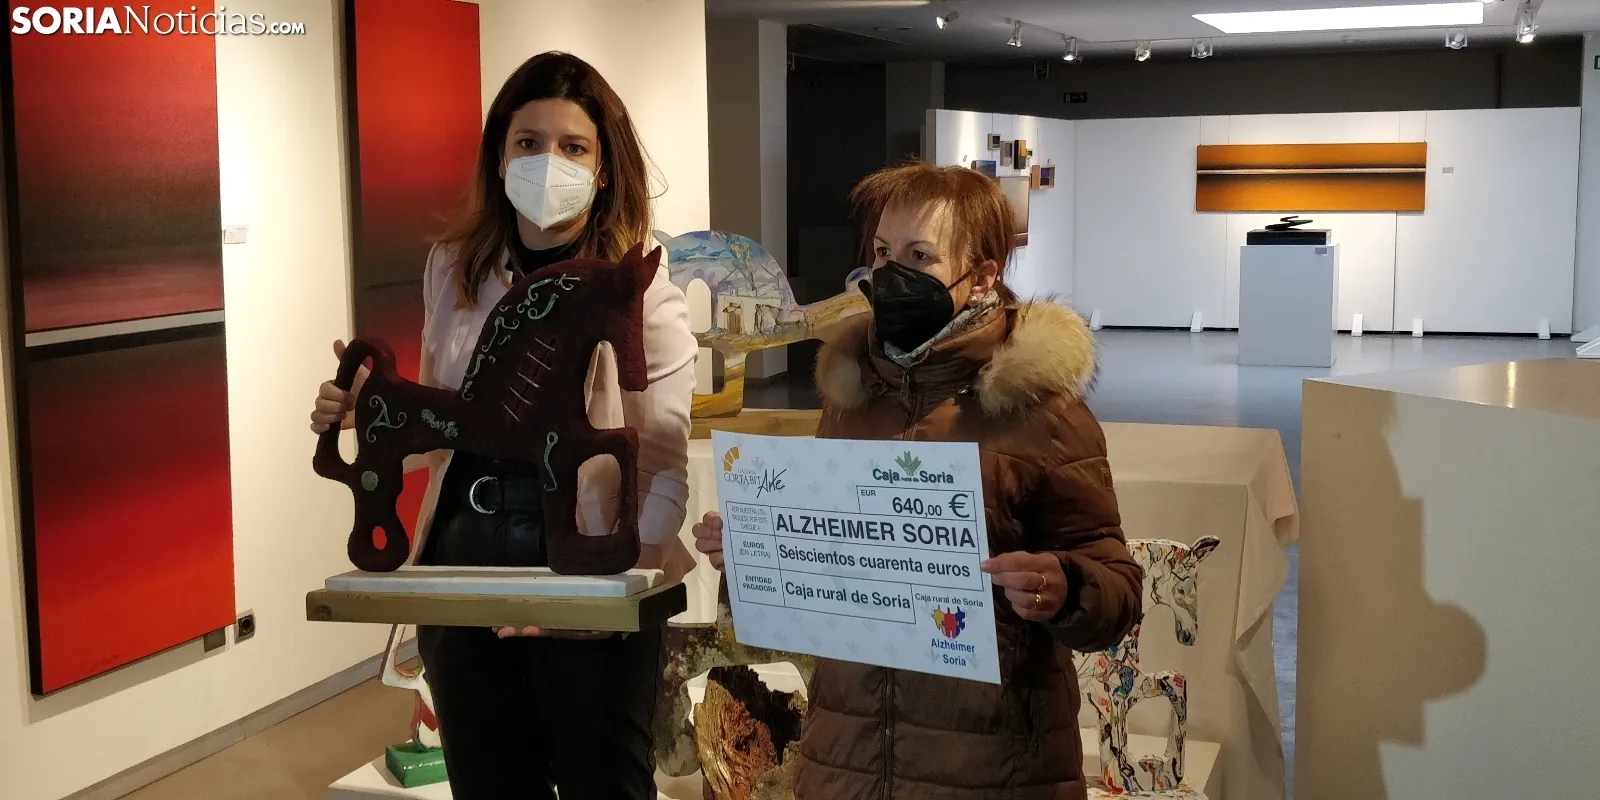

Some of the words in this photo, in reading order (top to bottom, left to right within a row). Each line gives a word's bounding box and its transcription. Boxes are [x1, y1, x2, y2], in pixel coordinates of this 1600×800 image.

[872, 468, 900, 484] Caja
[919, 470, 955, 484] Soria
[860, 489, 877, 497] EUR
[892, 496, 943, 518] 640,00
[948, 493, 970, 519] €
[776, 513, 895, 541] ALZHEIMER
[902, 522, 976, 548] SORIA
[743, 541, 765, 550] EUROS
[779, 544, 856, 567] Seiscientos
[859, 555, 923, 573] cuarenta
[927, 562, 971, 578] euros
[742, 582, 778, 593] PAGADORA
[745, 575, 773, 585] ENTIDAD
[785, 581, 815, 600] Caja
[816, 588, 848, 602] rural
[850, 590, 869, 604] de
[871, 592, 911, 609] Soria
[914, 592, 932, 602] Caja
[932, 595, 950, 604] rural
[951, 597, 962, 605] de
[963, 598, 984, 608] Soria
[931, 638, 976, 653] Alzheimer
[942, 654, 967, 667] Soria
